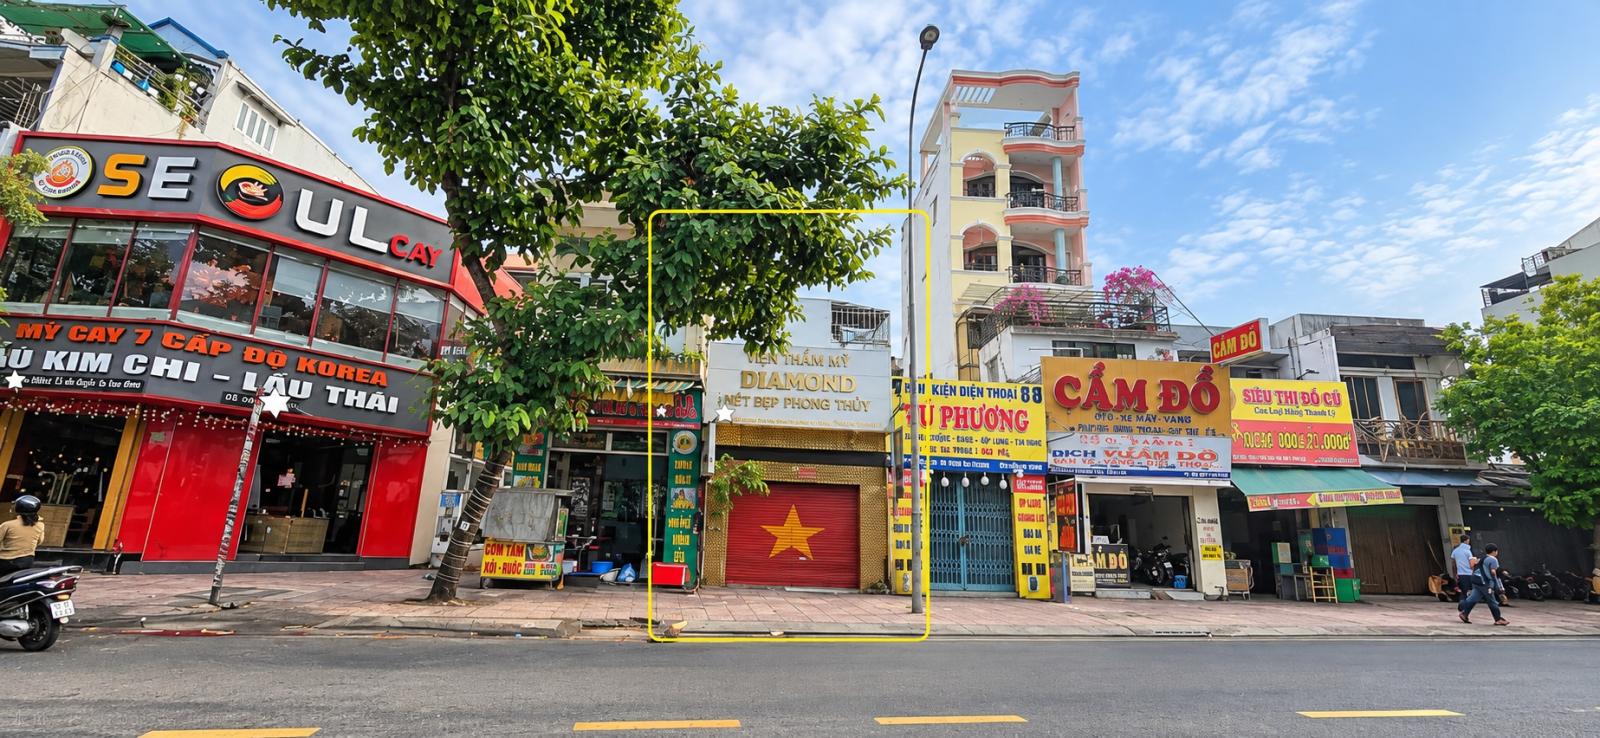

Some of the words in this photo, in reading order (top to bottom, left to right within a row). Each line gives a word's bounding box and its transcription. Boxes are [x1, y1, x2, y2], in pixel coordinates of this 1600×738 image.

[391, 235, 443, 267] CAY
[68, 325, 125, 343] CAY
[135, 329, 153, 345] 7
[162, 333, 232, 356] CẤP
[243, 347, 288, 370] ĐỘ
[296, 357, 388, 387] KOREA
[42, 350, 112, 373] KIM
[123, 354, 200, 382] CHI
[326, 384, 399, 414] THÁI
[740, 370, 857, 393] DIAMOND
[932, 382, 957, 398] KIỆN
[784, 397, 830, 410] PHONG
[939, 402, 1030, 433] PHƯƠNG
